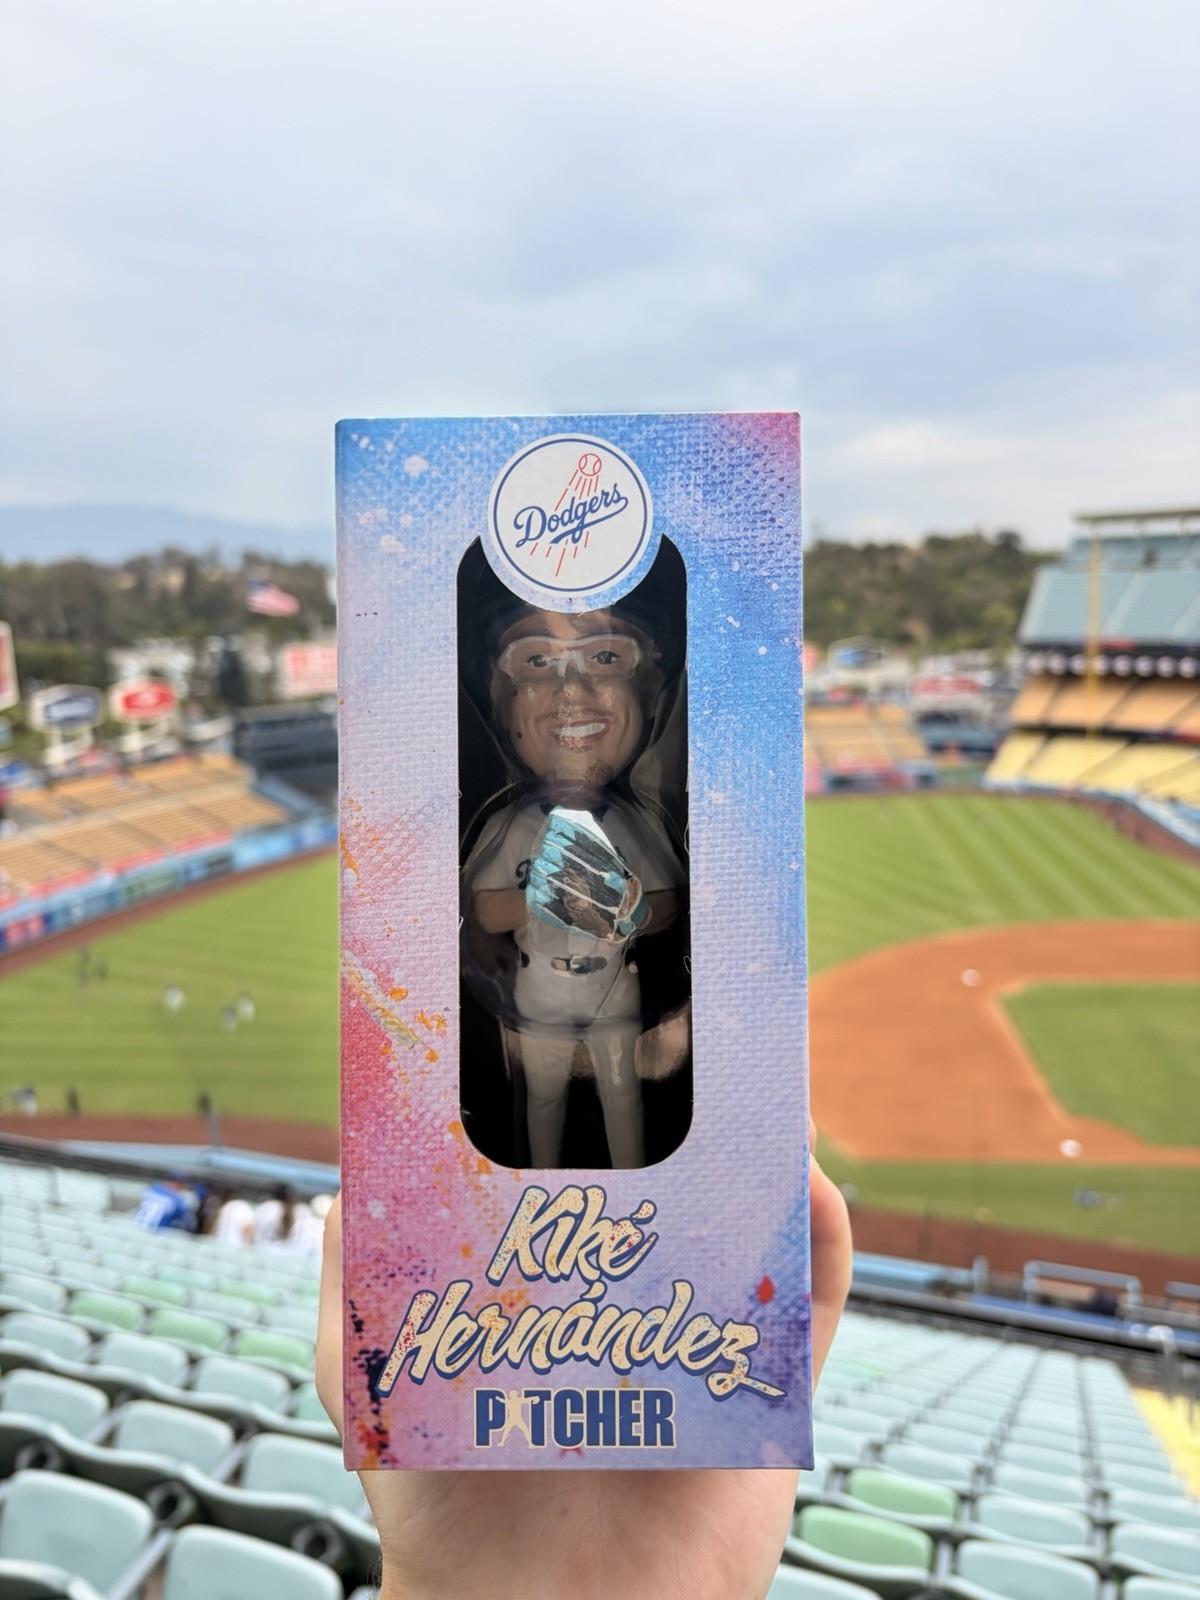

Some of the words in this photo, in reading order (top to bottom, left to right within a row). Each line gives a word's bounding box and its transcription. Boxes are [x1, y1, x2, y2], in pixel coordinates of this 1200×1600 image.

[513, 483, 628, 548] Dodgers
[486, 1184, 659, 1285] Kiké
[376, 1279, 788, 1401] Hernández
